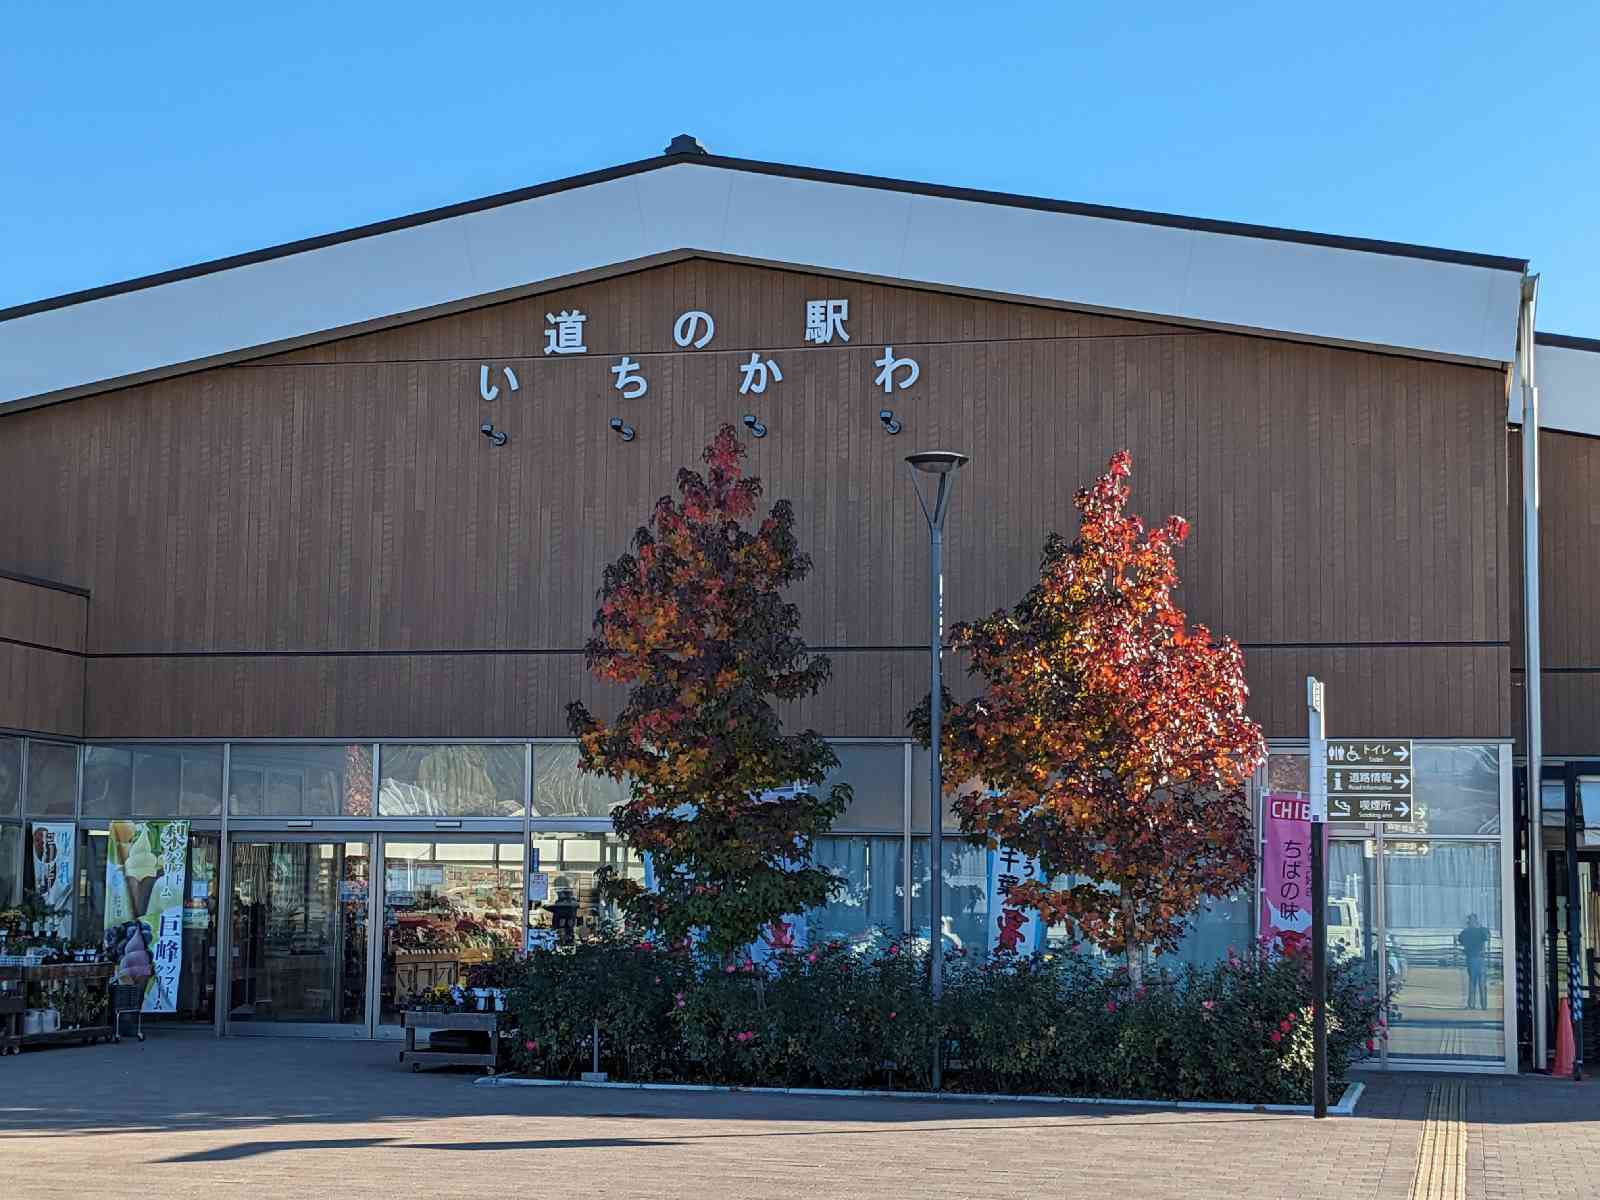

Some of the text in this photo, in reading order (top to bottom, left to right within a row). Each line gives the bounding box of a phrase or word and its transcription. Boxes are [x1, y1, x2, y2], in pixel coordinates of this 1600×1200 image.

[543, 299, 850, 355] 道の駅
[479, 346, 920, 401] いちかわ
[1363, 744, 1391, 755] トイレ
[1349, 772, 1392, 784] 道路情報
[1272, 801, 1310, 820] CHIB
[1360, 800, 1391, 811] 喫煙所
[155, 915, 181, 963] 巨峰
[153, 964, 165, 1011] クリーム
[164, 965, 177, 999] ソフト
